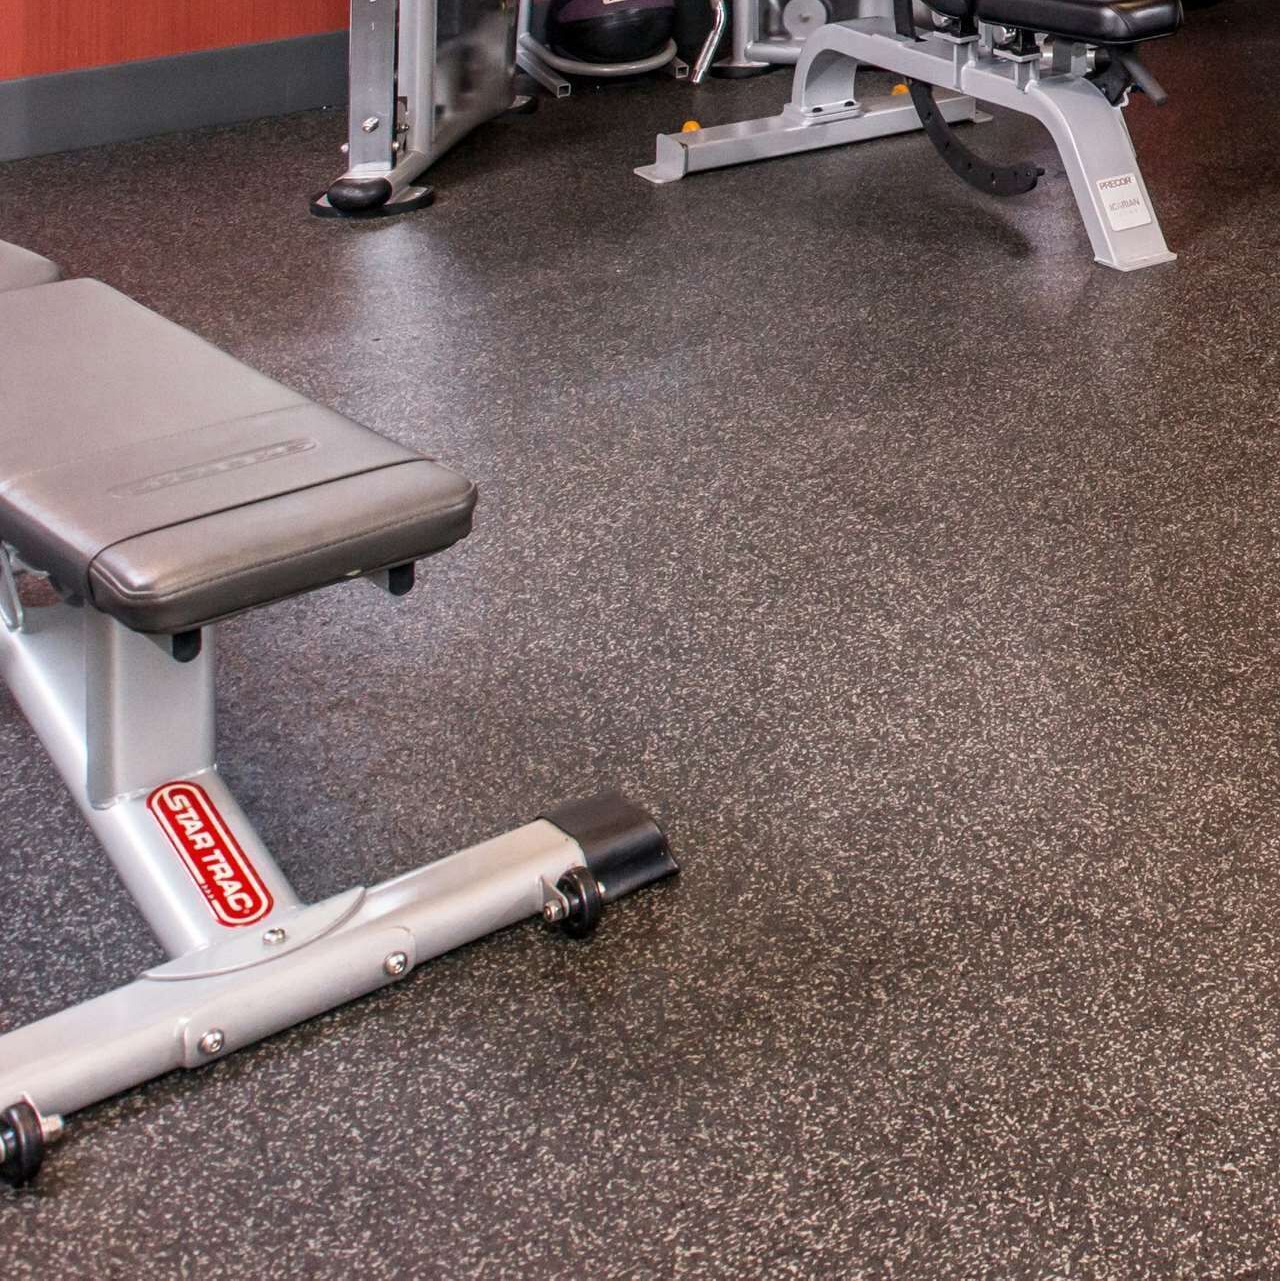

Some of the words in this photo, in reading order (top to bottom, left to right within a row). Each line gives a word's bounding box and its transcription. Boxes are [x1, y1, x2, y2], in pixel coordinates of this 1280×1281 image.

[1099, 175, 1133, 191] PRECOR
[162, 789, 217, 851] STAR
[201, 848, 254, 912] TRAC
